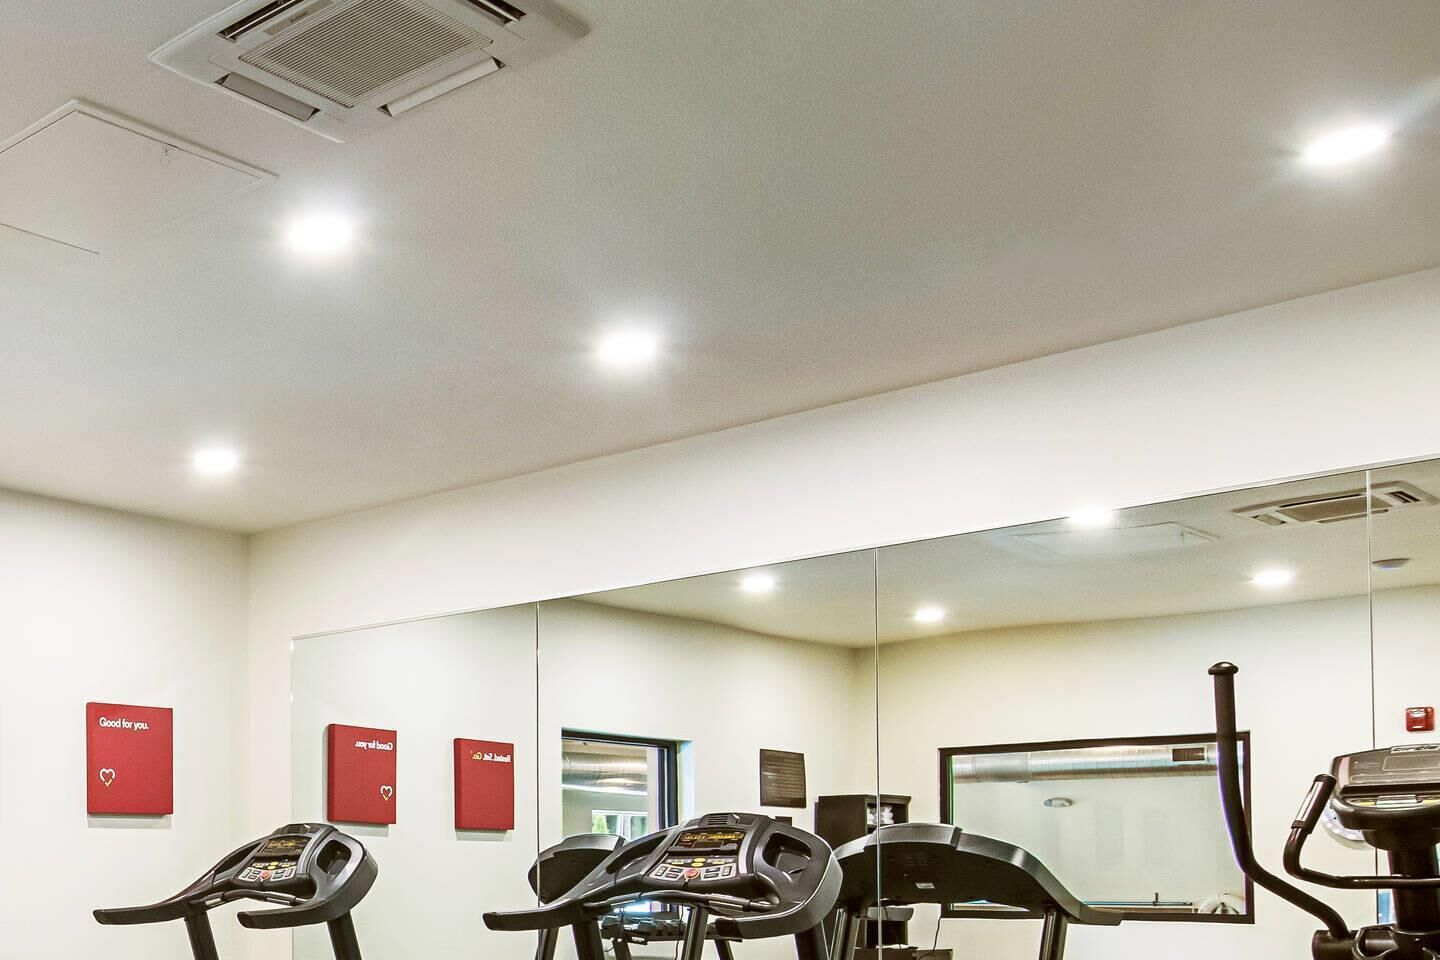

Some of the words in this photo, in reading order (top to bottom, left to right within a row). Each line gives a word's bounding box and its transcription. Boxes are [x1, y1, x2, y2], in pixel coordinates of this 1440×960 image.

[99, 716, 122, 728] Good
[122, 718, 132, 728] for
[133, 721, 149, 731] you.
